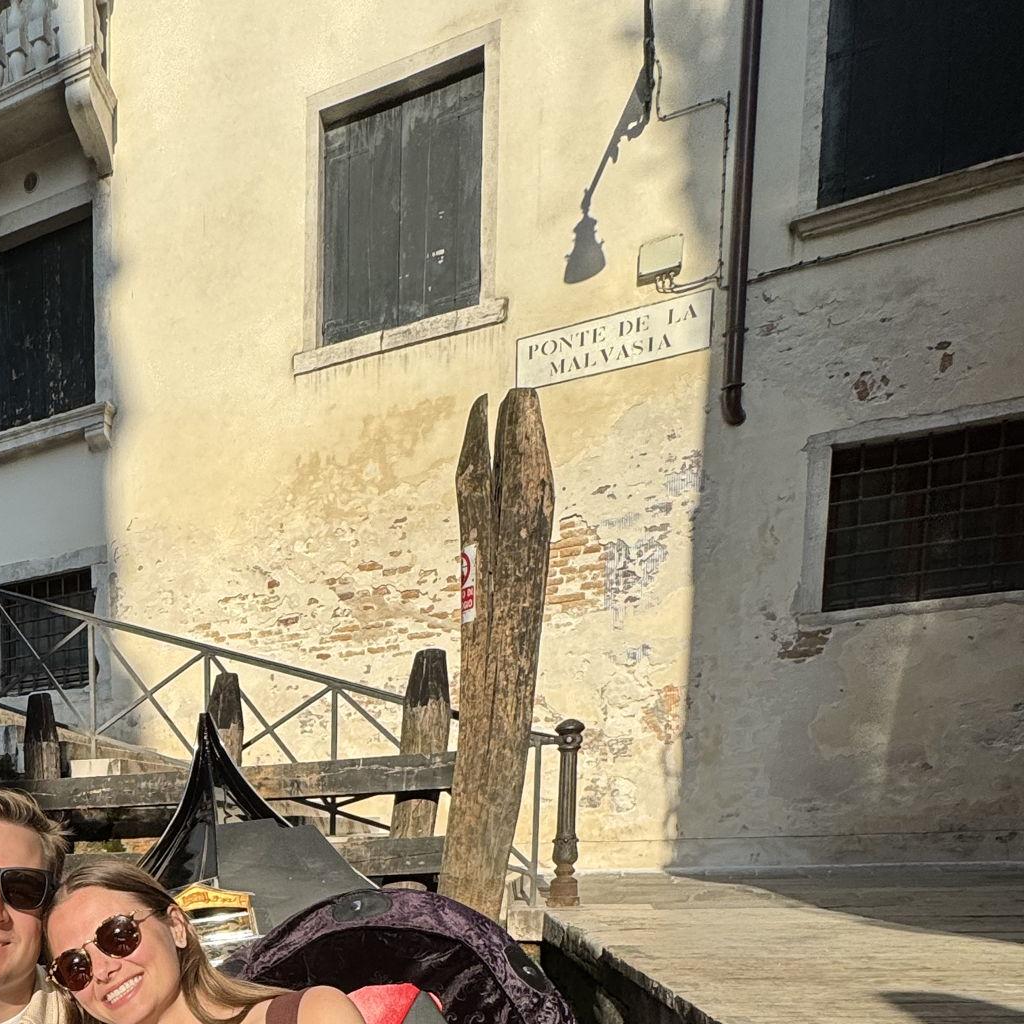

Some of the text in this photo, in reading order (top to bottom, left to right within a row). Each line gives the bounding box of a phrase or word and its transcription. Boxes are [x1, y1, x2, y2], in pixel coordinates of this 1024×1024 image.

[528, 303, 698, 360] PONTE DE LA
[549, 333, 671, 377] MALVASIA
